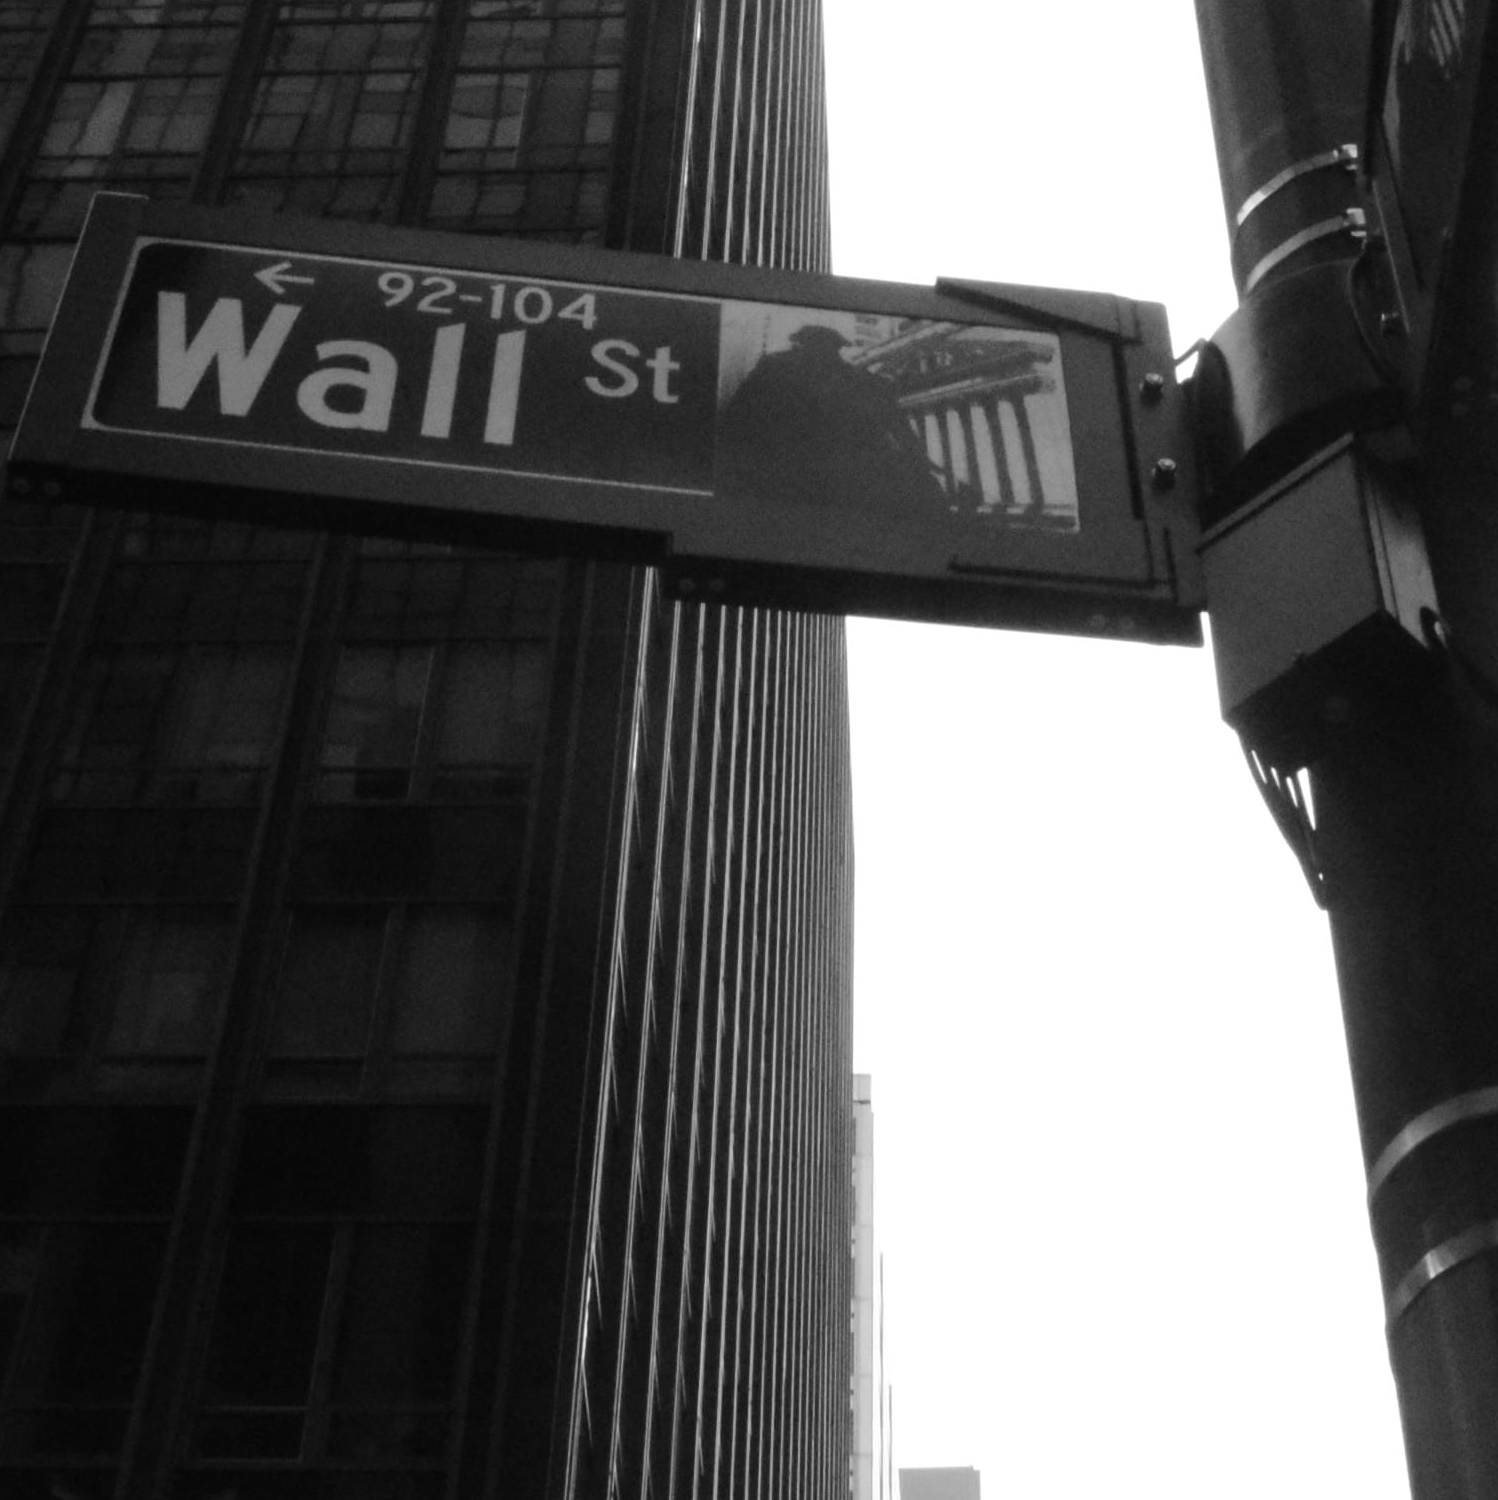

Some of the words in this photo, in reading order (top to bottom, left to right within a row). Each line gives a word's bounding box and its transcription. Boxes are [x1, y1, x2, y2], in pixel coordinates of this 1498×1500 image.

[377, 271, 598, 330] 92-104
[157, 290, 527, 446] Wall
[584, 338, 681, 403] St
